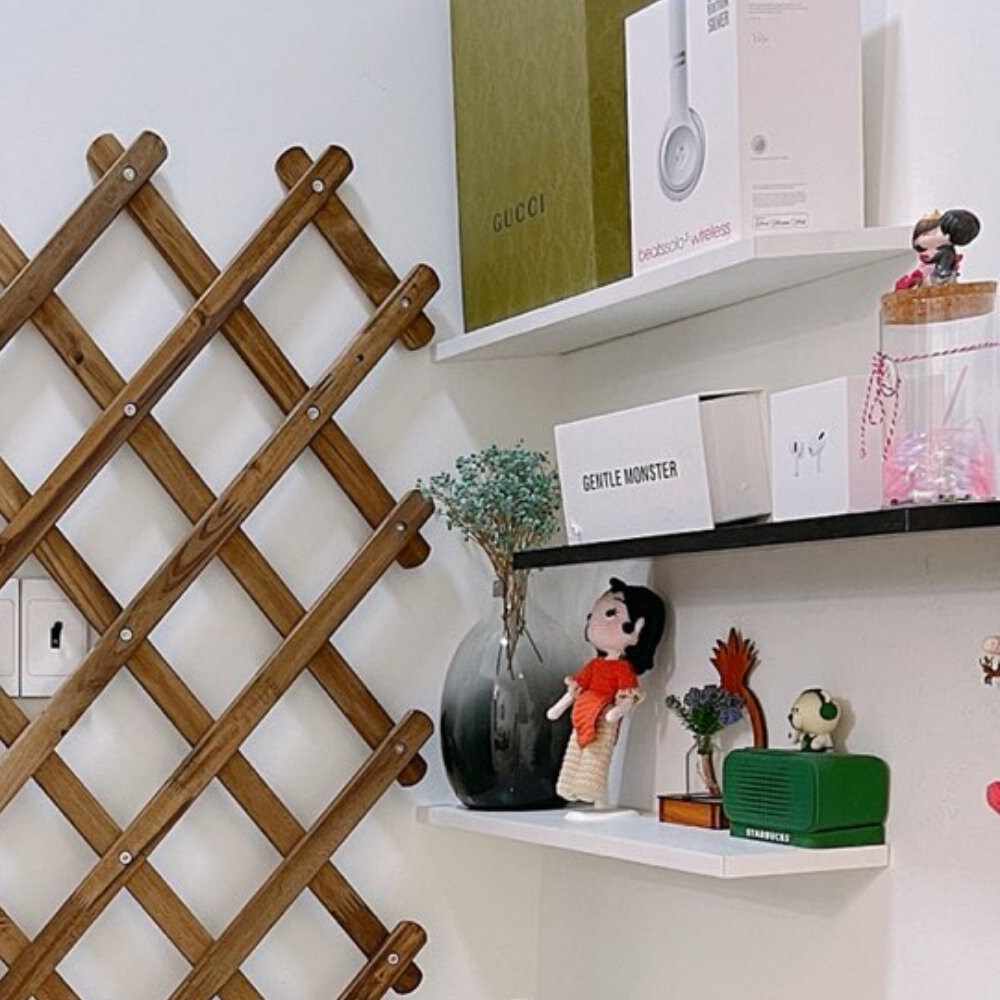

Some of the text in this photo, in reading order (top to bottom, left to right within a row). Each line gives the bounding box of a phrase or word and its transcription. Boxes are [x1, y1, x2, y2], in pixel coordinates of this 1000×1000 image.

[492, 193, 545, 232] GUCCI
[582, 460, 678, 492] GENTLE MONSTER
[745, 828, 790, 843] STARBUCKS
